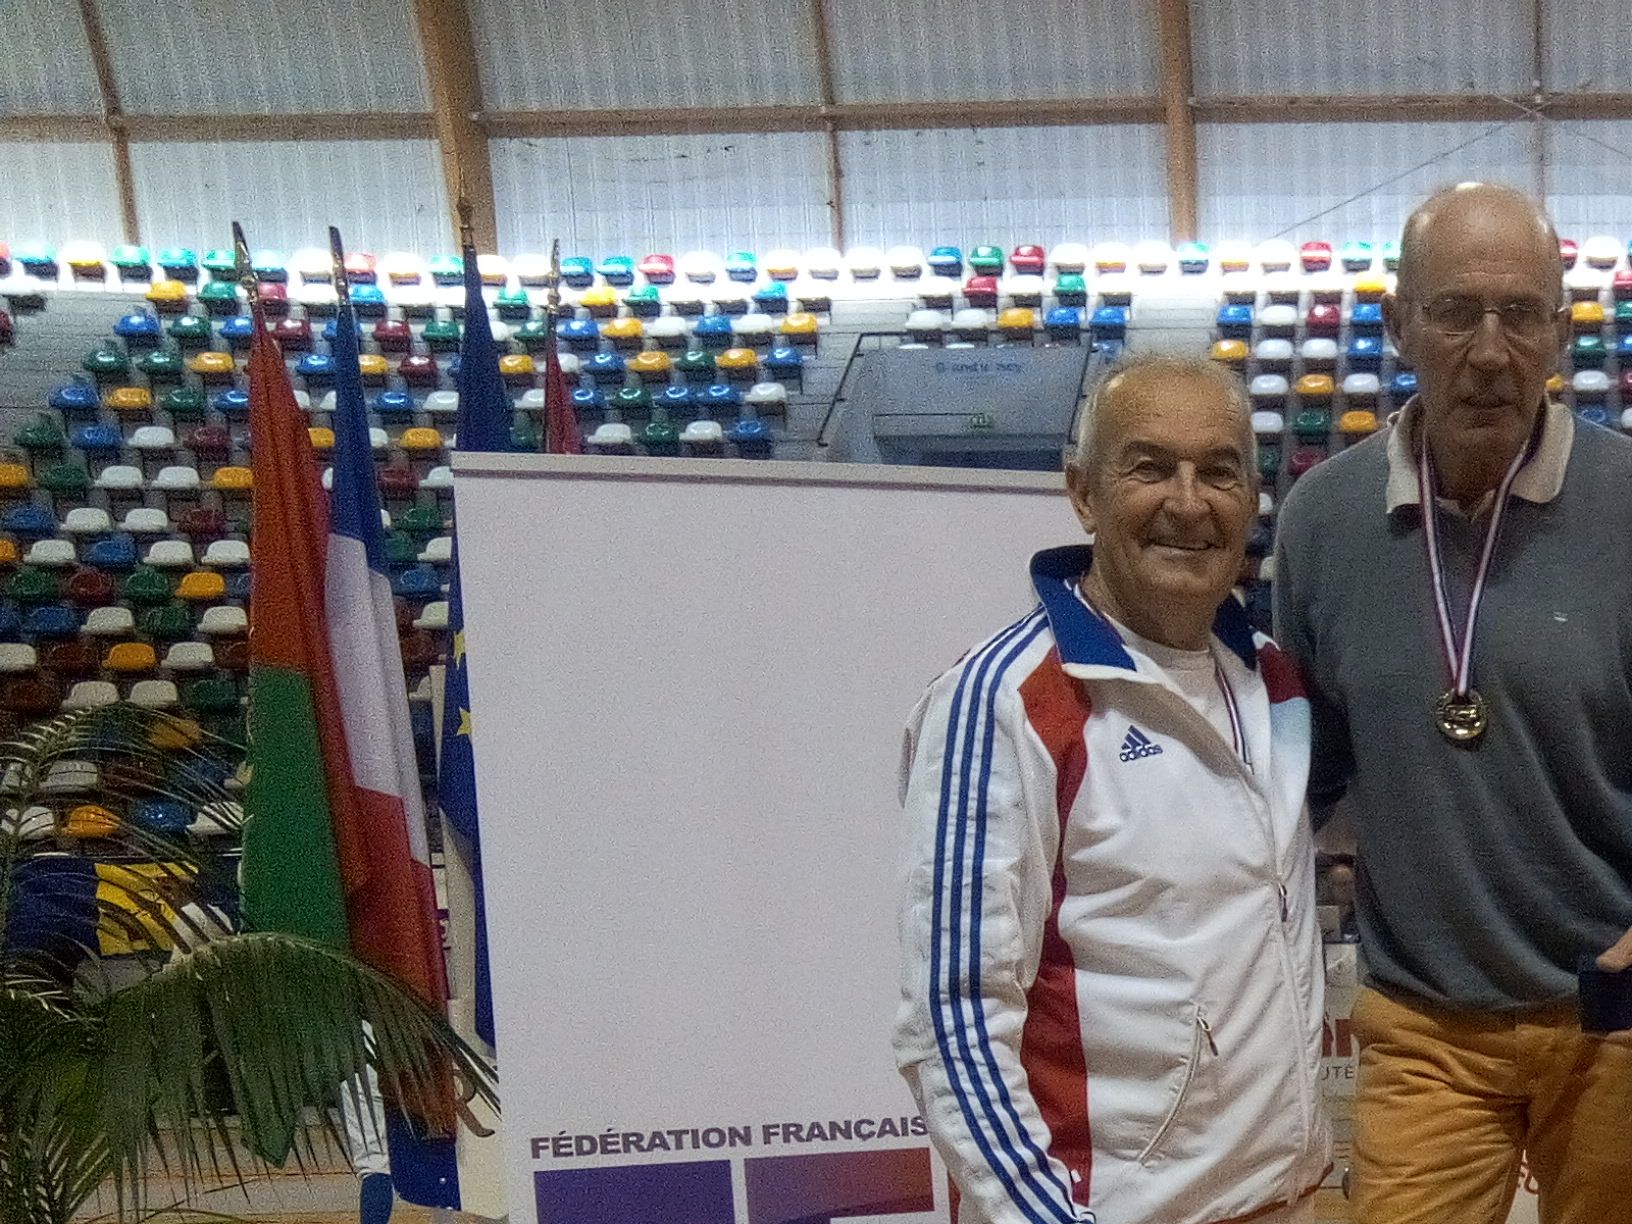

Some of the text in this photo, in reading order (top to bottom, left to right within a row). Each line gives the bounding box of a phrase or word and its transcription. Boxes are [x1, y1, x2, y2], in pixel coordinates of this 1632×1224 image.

[1119, 743, 1163, 762] adidas
[530, 1115, 930, 1160] FÉDÉRATION FRANÇAIS
